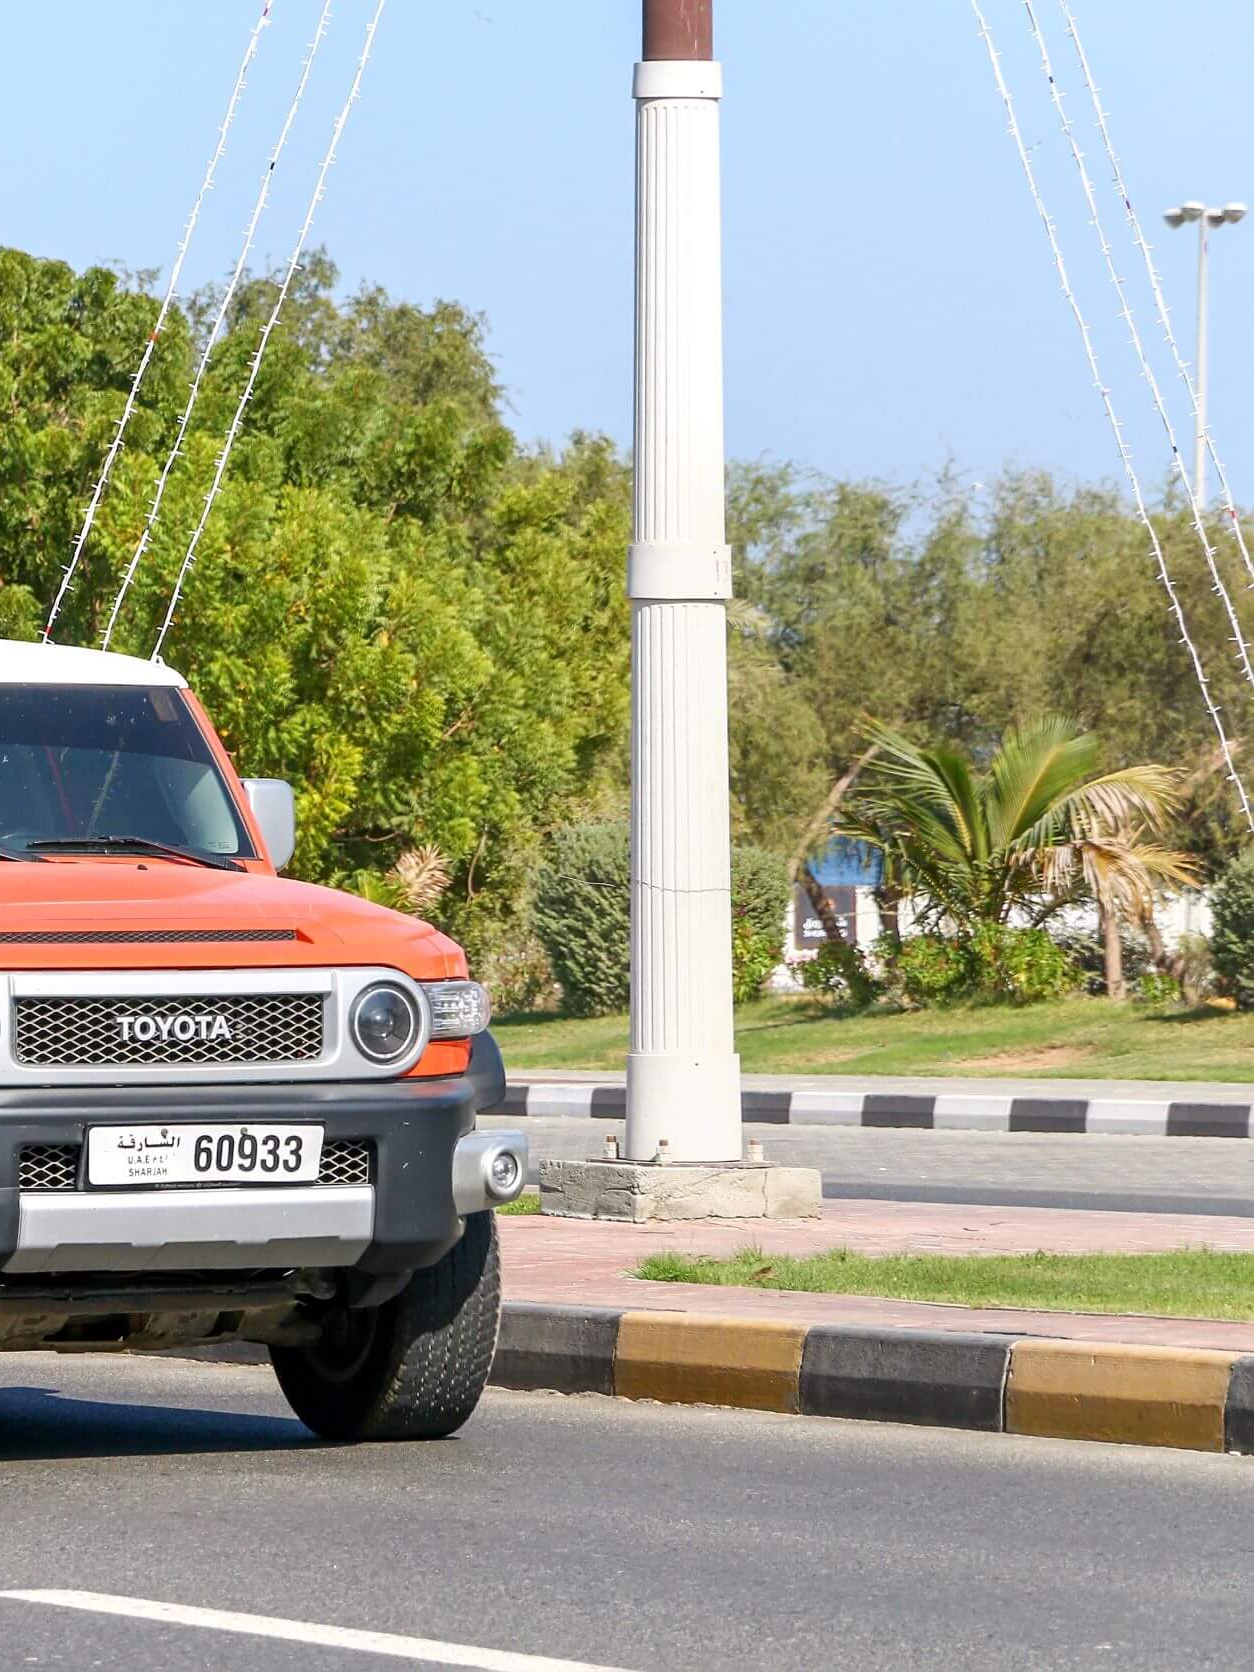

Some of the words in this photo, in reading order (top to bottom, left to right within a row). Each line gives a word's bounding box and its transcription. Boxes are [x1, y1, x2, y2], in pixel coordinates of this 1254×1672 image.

[116, 1015, 232, 1041] TOYOTA
[117, 1133, 181, 1152] الشارقة
[194, 1134, 304, 1173] 60933
[128, 1167, 168, 1177] SHARJAH
